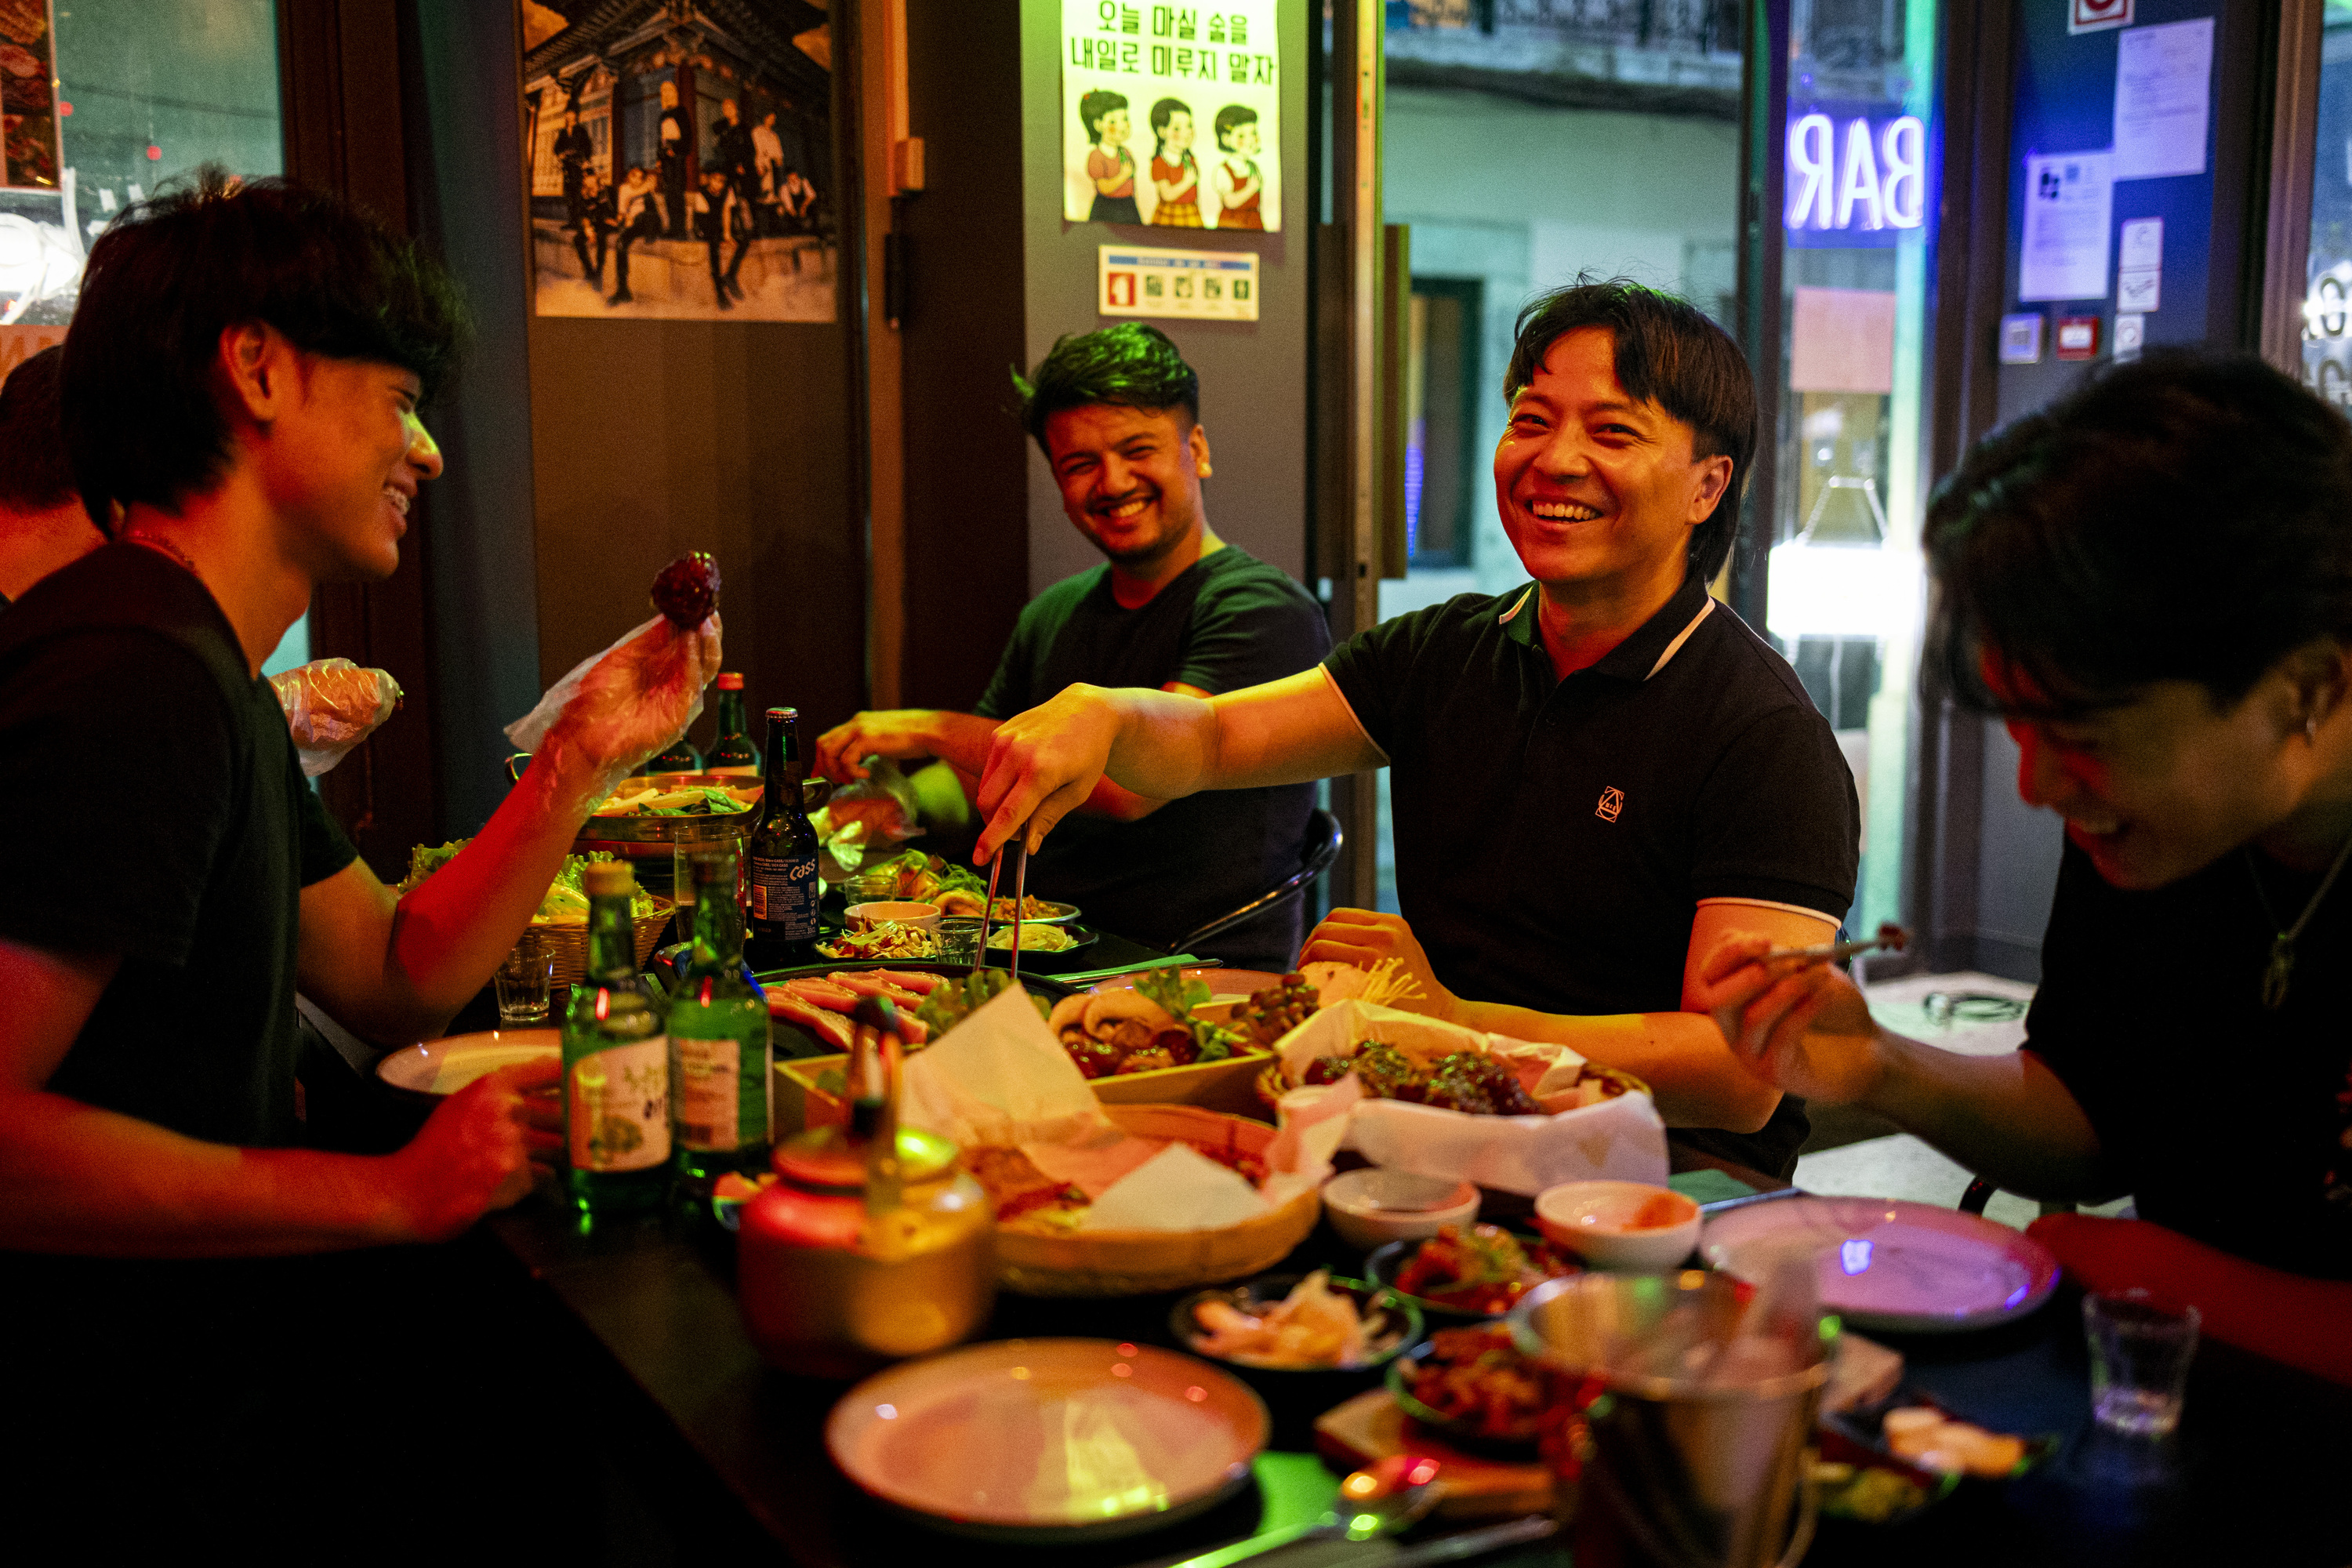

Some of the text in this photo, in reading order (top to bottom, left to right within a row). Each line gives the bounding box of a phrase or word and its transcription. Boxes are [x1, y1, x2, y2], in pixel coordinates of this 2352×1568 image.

[1098, 0, 1248, 45] 오늘 마실 술을
[1071, 38, 1276, 85] 내일로 미루지 말자
